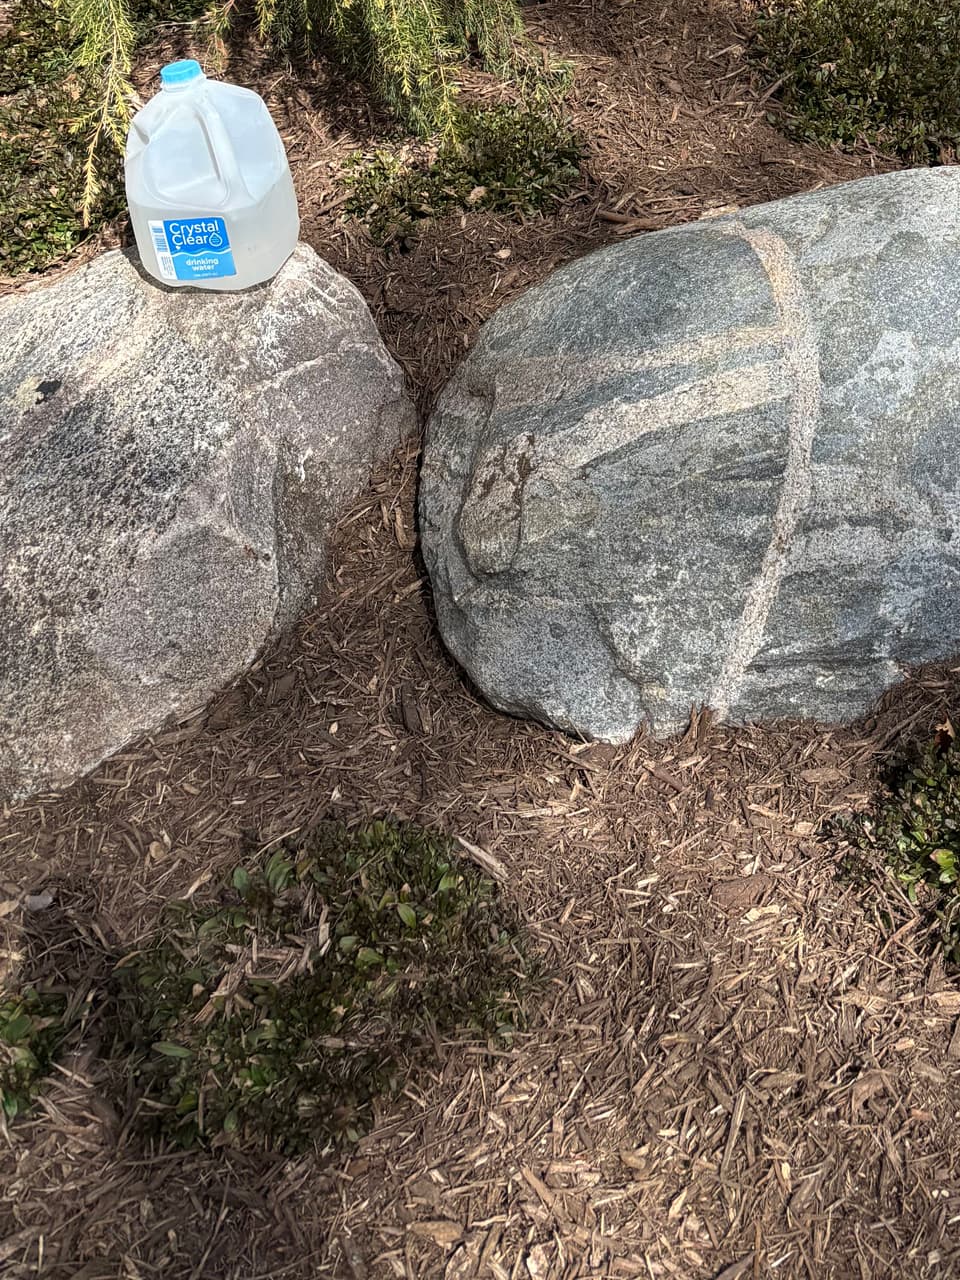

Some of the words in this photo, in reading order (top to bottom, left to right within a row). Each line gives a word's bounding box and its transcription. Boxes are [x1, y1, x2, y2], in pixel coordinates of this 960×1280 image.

[169, 220, 219, 237] Crystal
[172, 232, 208, 246] Clear
[186, 257, 219, 267] drinking
[192, 264, 215, 272] water
